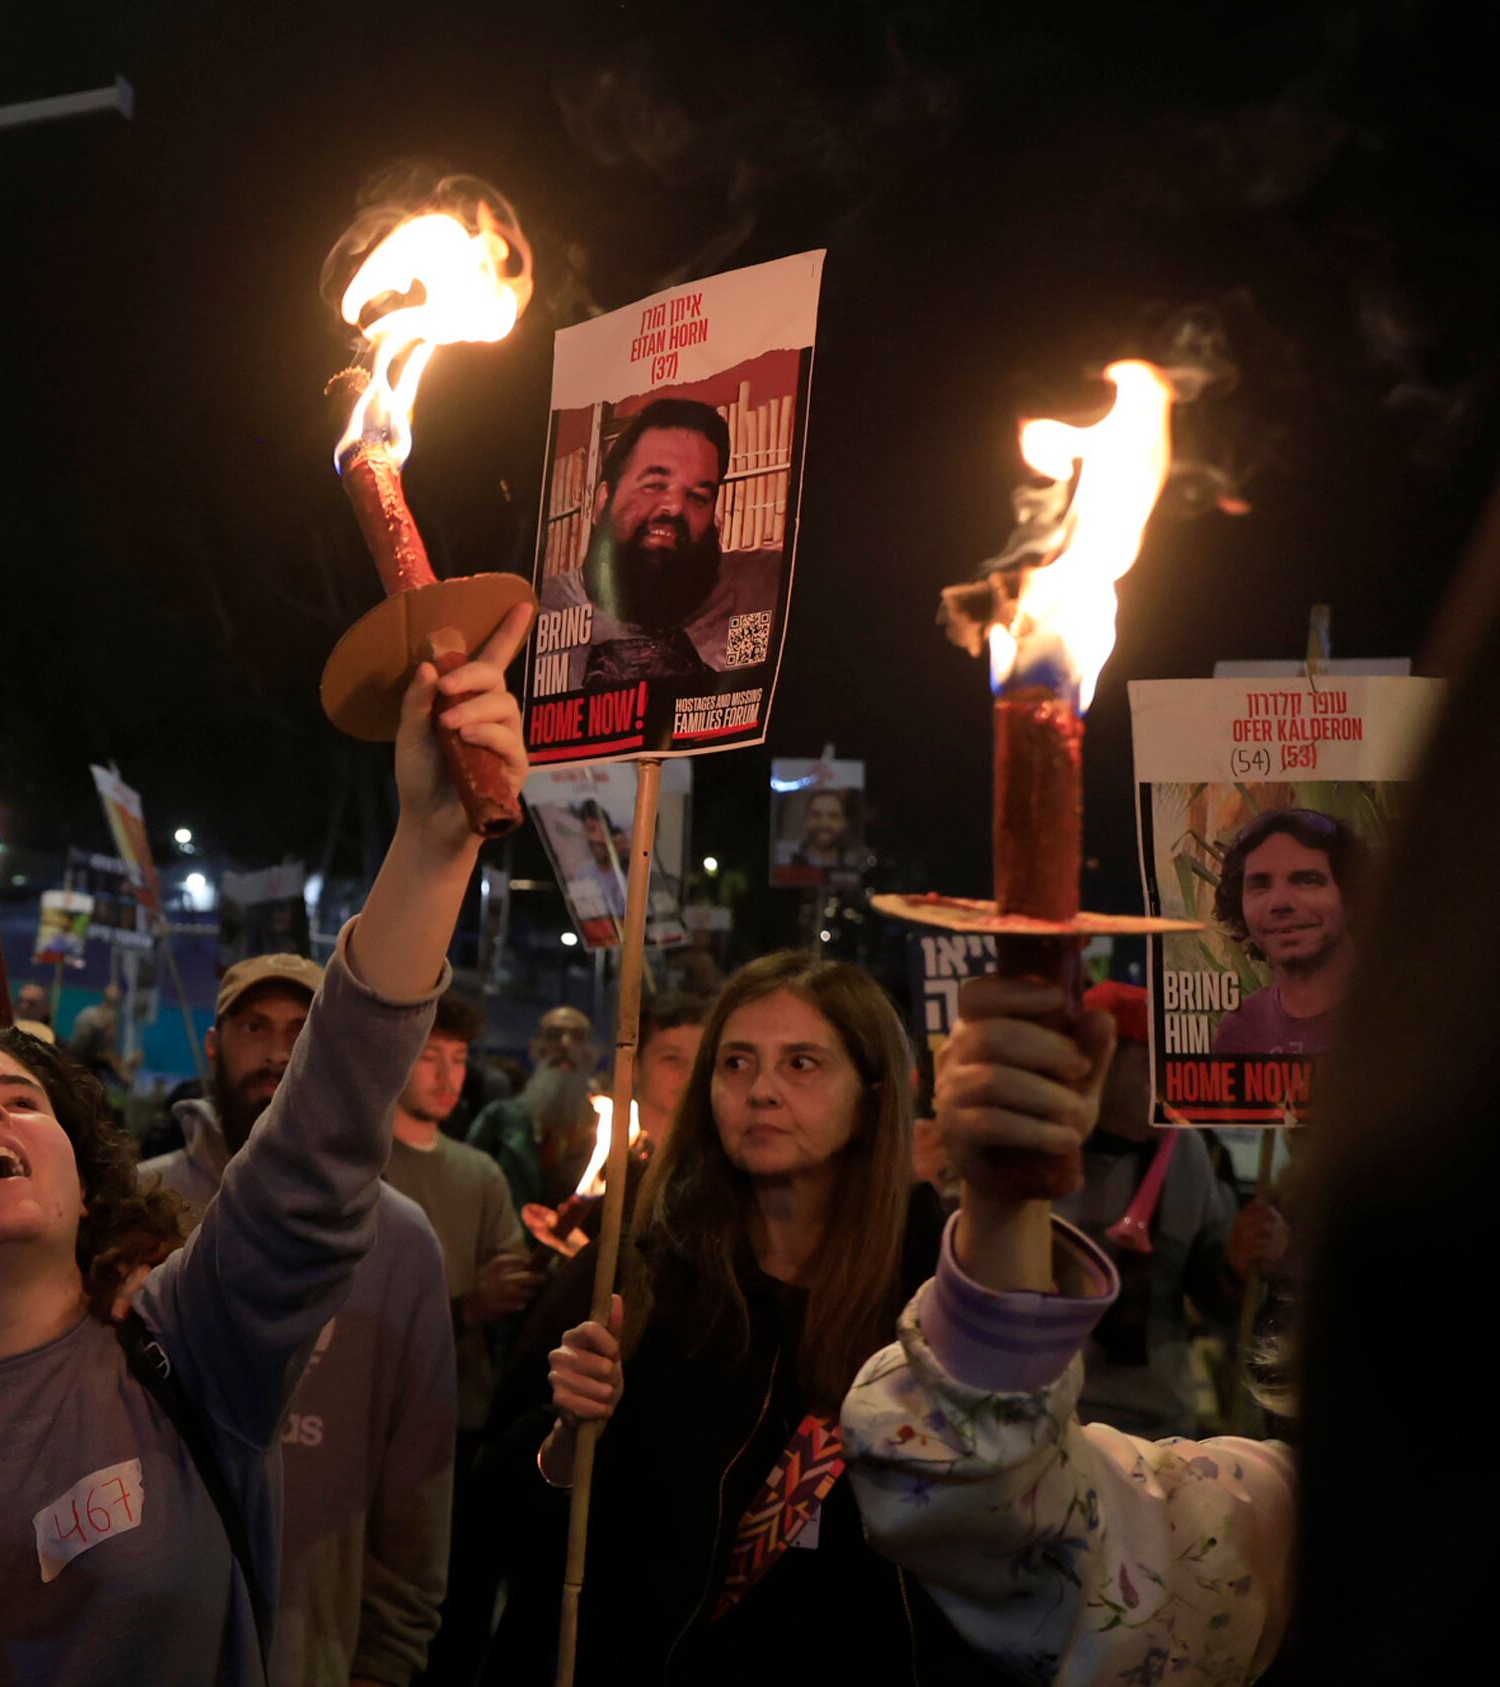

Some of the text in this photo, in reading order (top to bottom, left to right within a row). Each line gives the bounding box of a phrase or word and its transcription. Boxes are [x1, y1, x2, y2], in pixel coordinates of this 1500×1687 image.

[640, 293, 703, 335] איתן הורן
[630, 318, 709, 363] EITAN HORN
[651, 352, 679, 384] (37)
[537, 603, 594, 655] BRING
[533, 653, 570, 698] HIM
[529, 680, 648, 746] HOME NOW!
[674, 702, 760, 734] FAMILIES FORUM
[675, 687, 763, 713] HOSTAGES AND MISSING
[1246, 691, 1348, 719] עופר קלדרון
[1232, 717, 1364, 743] OFER KALDERON
[1230, 747, 1271, 777] (54)
[1280, 743, 1318, 769] (53)
[1163, 970, 1241, 1012] BRING
[1164, 1013, 1210, 1055] HIM
[1166, 1061, 1237, 1103] HOME
[54, 1476, 133, 1544] 467
